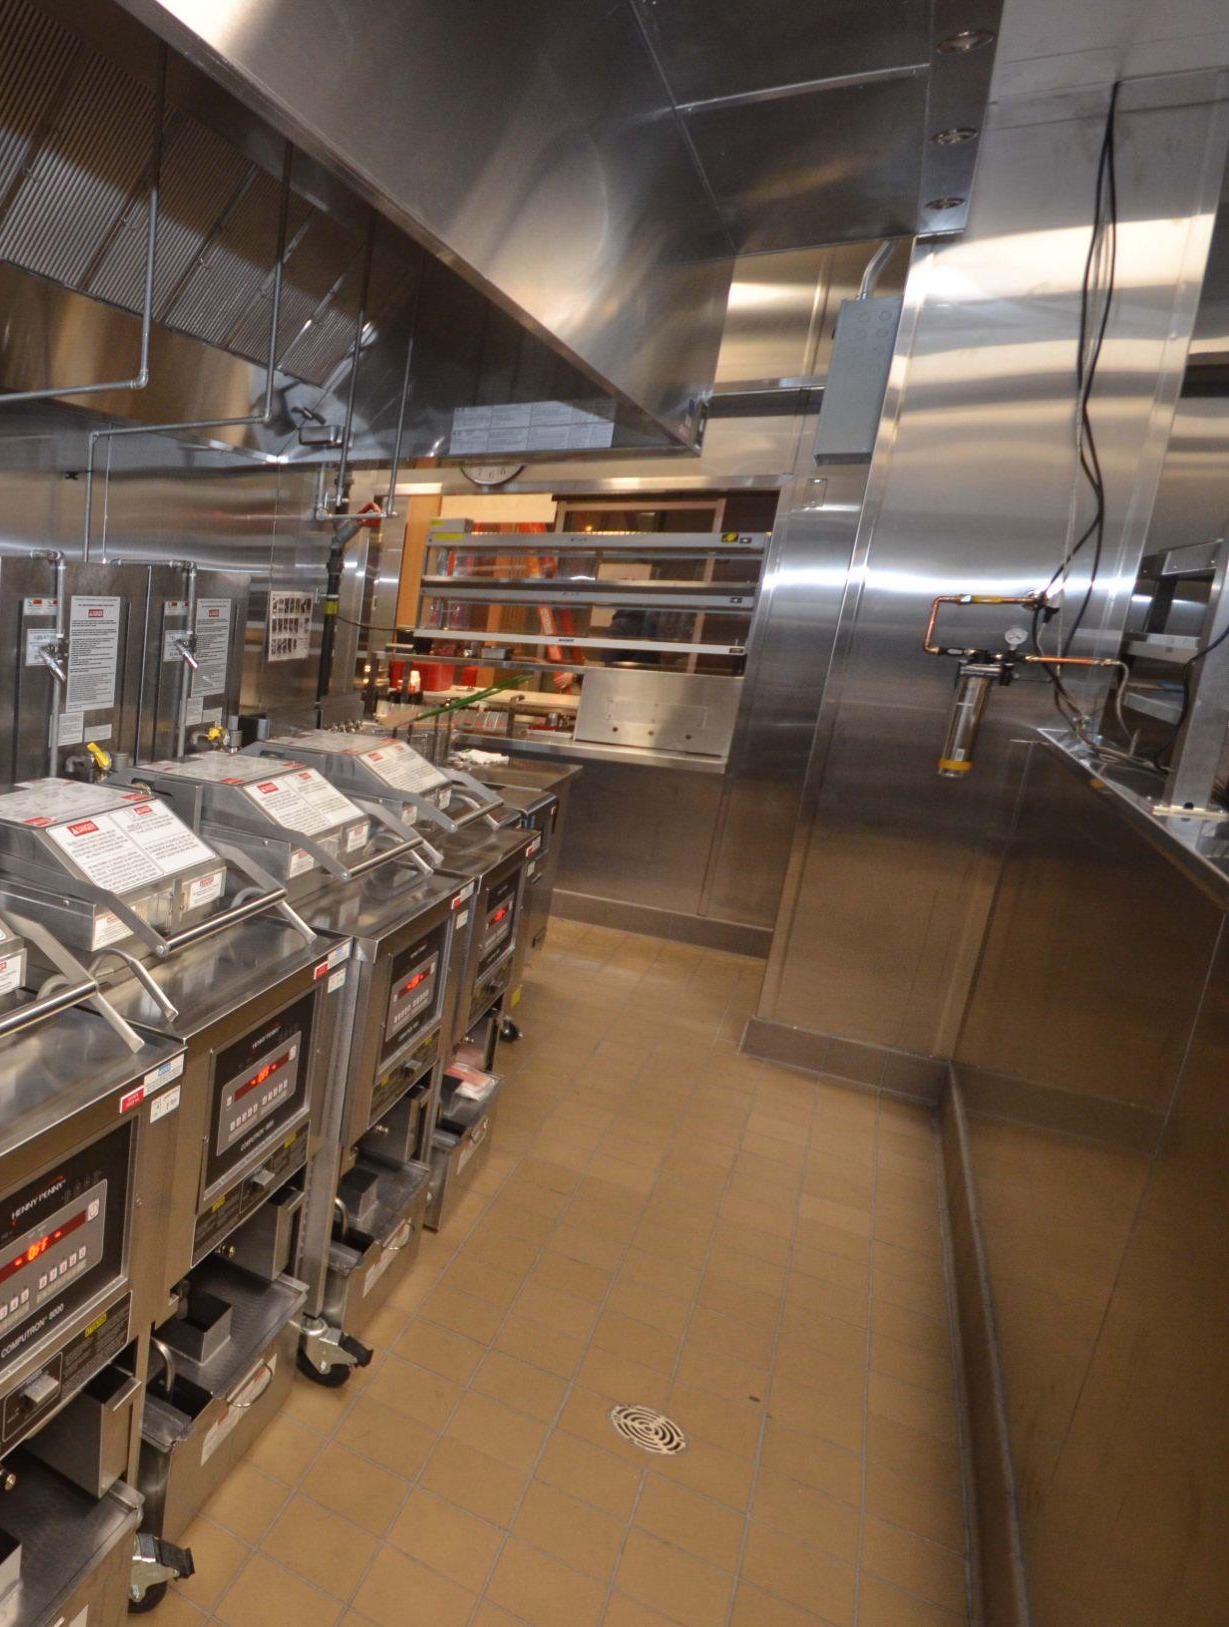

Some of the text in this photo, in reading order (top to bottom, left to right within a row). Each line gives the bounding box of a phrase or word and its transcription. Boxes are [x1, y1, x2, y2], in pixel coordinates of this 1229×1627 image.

[12, 1182, 64, 1219] HENNY PENNY
[0, 1318, 46, 1358] COMPUTRON
